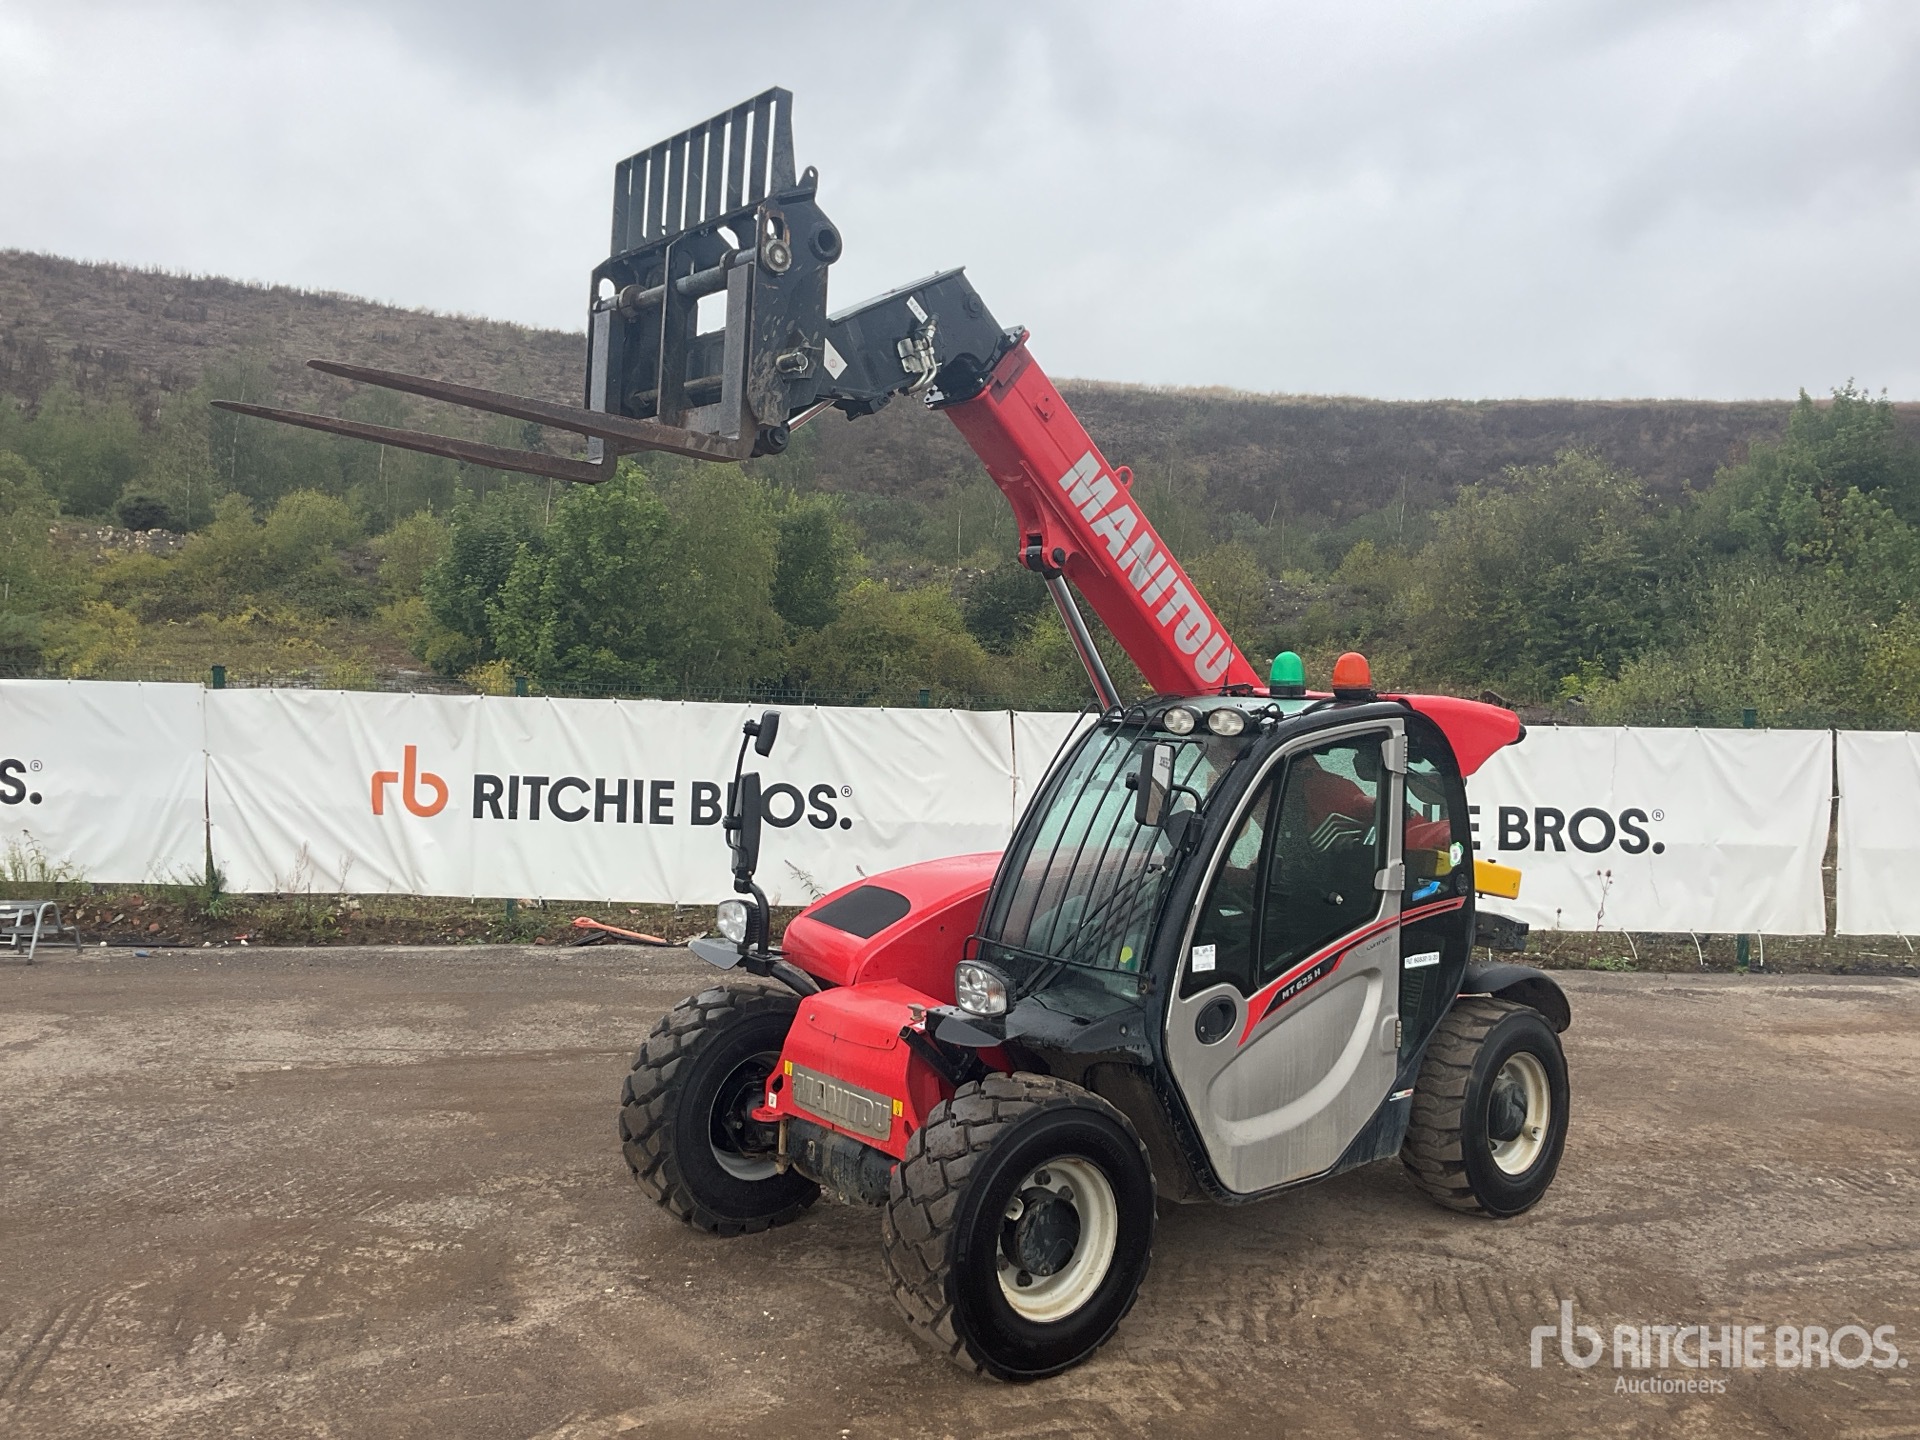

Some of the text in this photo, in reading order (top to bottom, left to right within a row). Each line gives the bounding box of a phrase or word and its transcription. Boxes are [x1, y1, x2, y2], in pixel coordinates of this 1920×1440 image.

[1058, 450, 1235, 684] MANITOU
[371, 745, 449, 818] rb
[473, 774, 675, 825] RITCHIE
[1283, 968, 1321, 1000] MT 625 H
[796, 1071, 890, 1133] MANITOU
